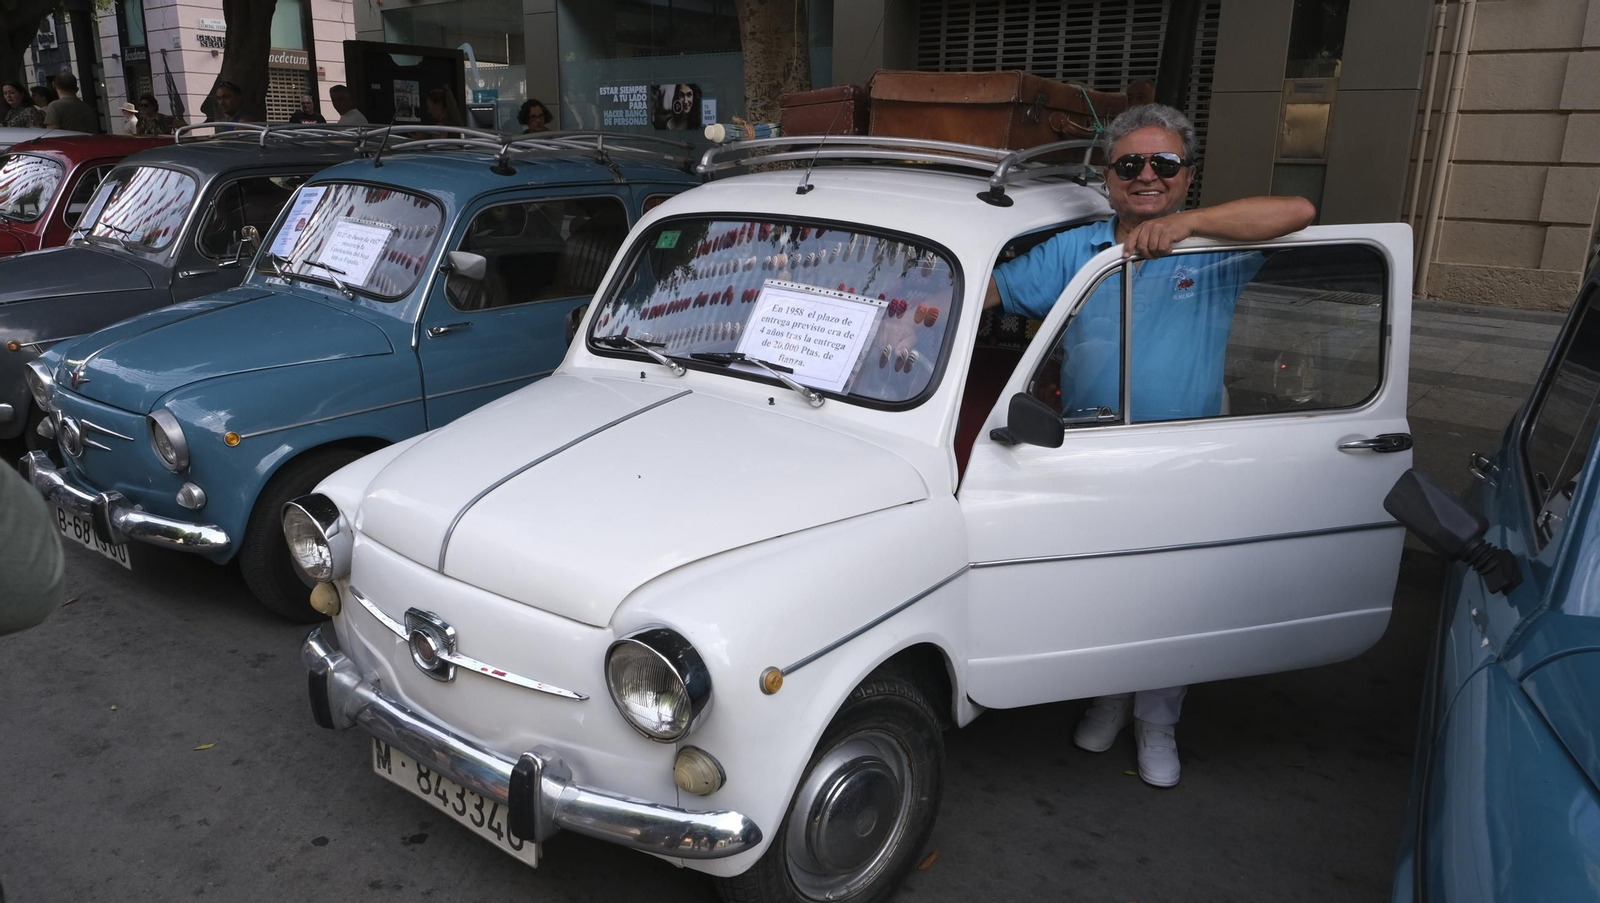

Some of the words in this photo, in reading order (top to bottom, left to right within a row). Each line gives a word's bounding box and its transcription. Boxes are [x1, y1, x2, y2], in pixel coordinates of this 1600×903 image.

[268, 51, 308, 65] nedetum
[600, 86, 619, 95] ESTAR
[619, 85, 647, 94] SIEMPRE
[629, 93, 647, 102] LADO
[629, 101, 648, 110] PARA
[603, 110, 624, 118] HACER
[624, 109, 648, 118] BANCA
[604, 118, 613, 126] DE
[613, 117, 648, 126] PERSONAS
[771, 304, 784, 313] En
[785, 306, 804, 316] 1958
[807, 310, 815, 319] el
[815, 312, 840, 324] plazo
[841, 317, 853, 327] de
[760, 316, 790, 327] entrega
[791, 321, 826, 334] previsto
[827, 329, 842, 337] era
[843, 330, 855, 340] de
[759, 326, 766, 334] 4
[766, 328, 784, 338] años
[785, 332, 802, 341] tras
[803, 334, 812, 343] la
[813, 338, 846, 351] entrega
[761, 338, 772, 348] de
[773, 340, 800, 352] 20.000
[800, 346, 821, 358] Ptas.
[822, 351, 834, 361] de
[778, 354, 805, 367] fianza.
